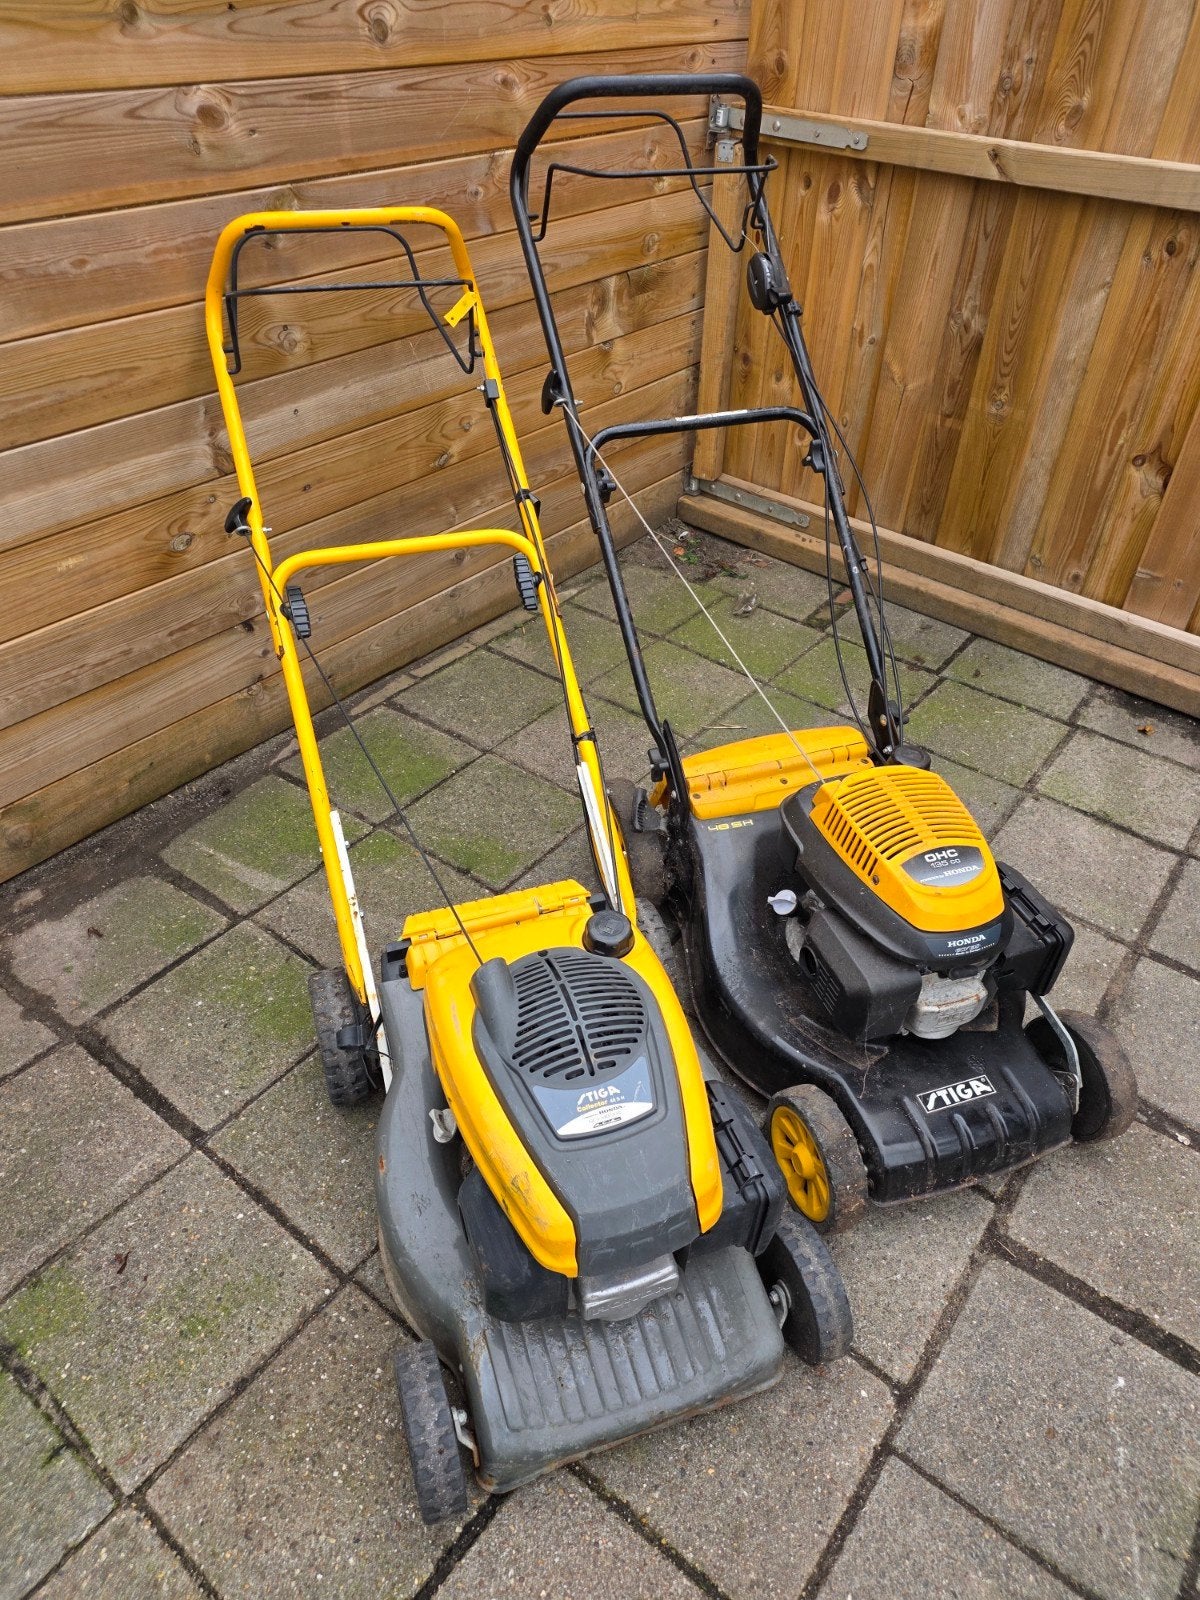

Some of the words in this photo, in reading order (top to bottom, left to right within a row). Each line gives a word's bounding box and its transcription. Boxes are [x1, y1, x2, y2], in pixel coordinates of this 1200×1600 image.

[924, 849, 959, 863] OHC
[930, 860, 949, 869] 135
[943, 865, 981, 877] HONDA
[947, 934, 986, 948] HONDA
[577, 1086, 620, 1105] STIGA
[926, 1079, 993, 1111] STIGA
